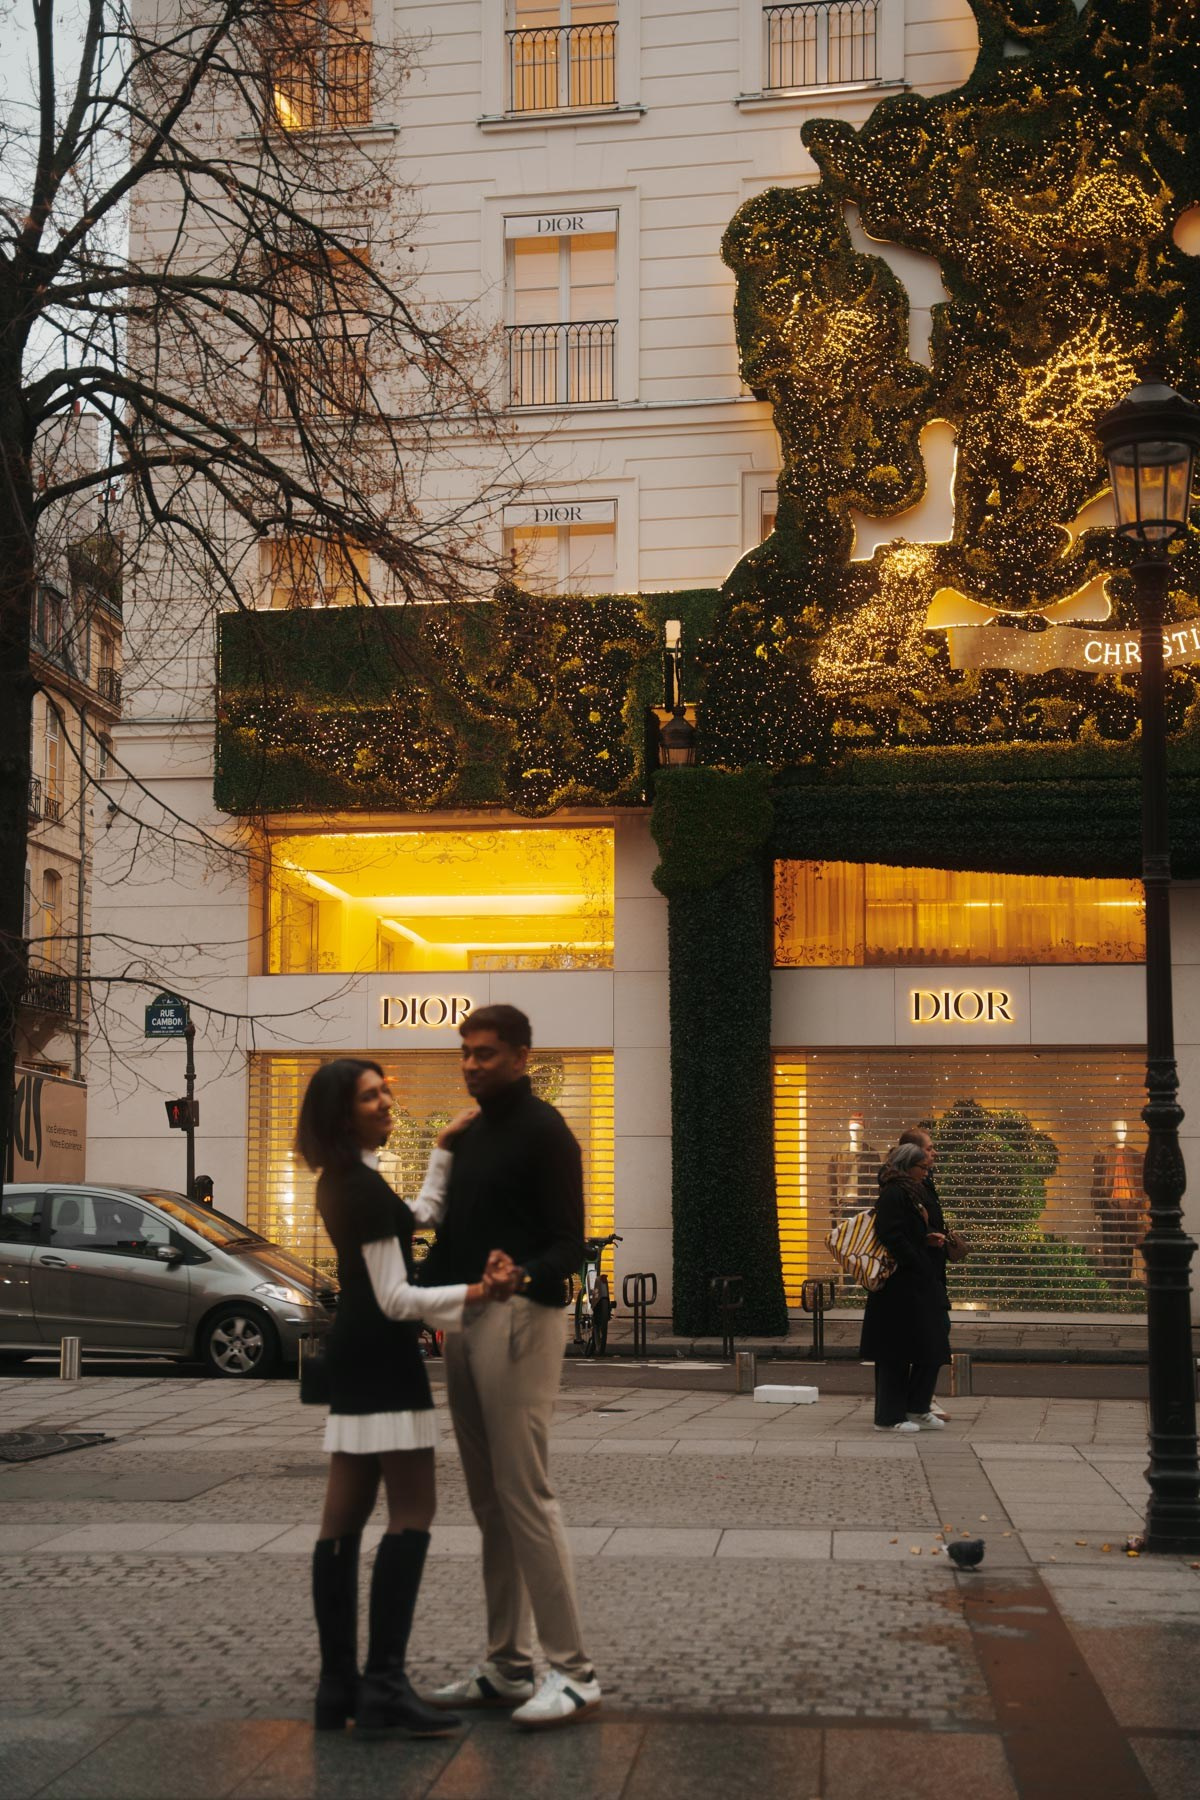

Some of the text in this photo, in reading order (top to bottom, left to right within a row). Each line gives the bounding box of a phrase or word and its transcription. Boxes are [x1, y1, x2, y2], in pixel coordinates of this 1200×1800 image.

[537, 216, 585, 233] DIOR
[535, 506, 583, 523] DIOR
[1084, 628, 1200, 665] CHRSTI
[160, 1009, 175, 1017] RUE
[381, 997, 472, 1026] DIOR
[911, 991, 1014, 1021] DIOR
[151, 1018, 183, 1026] CAMBON
